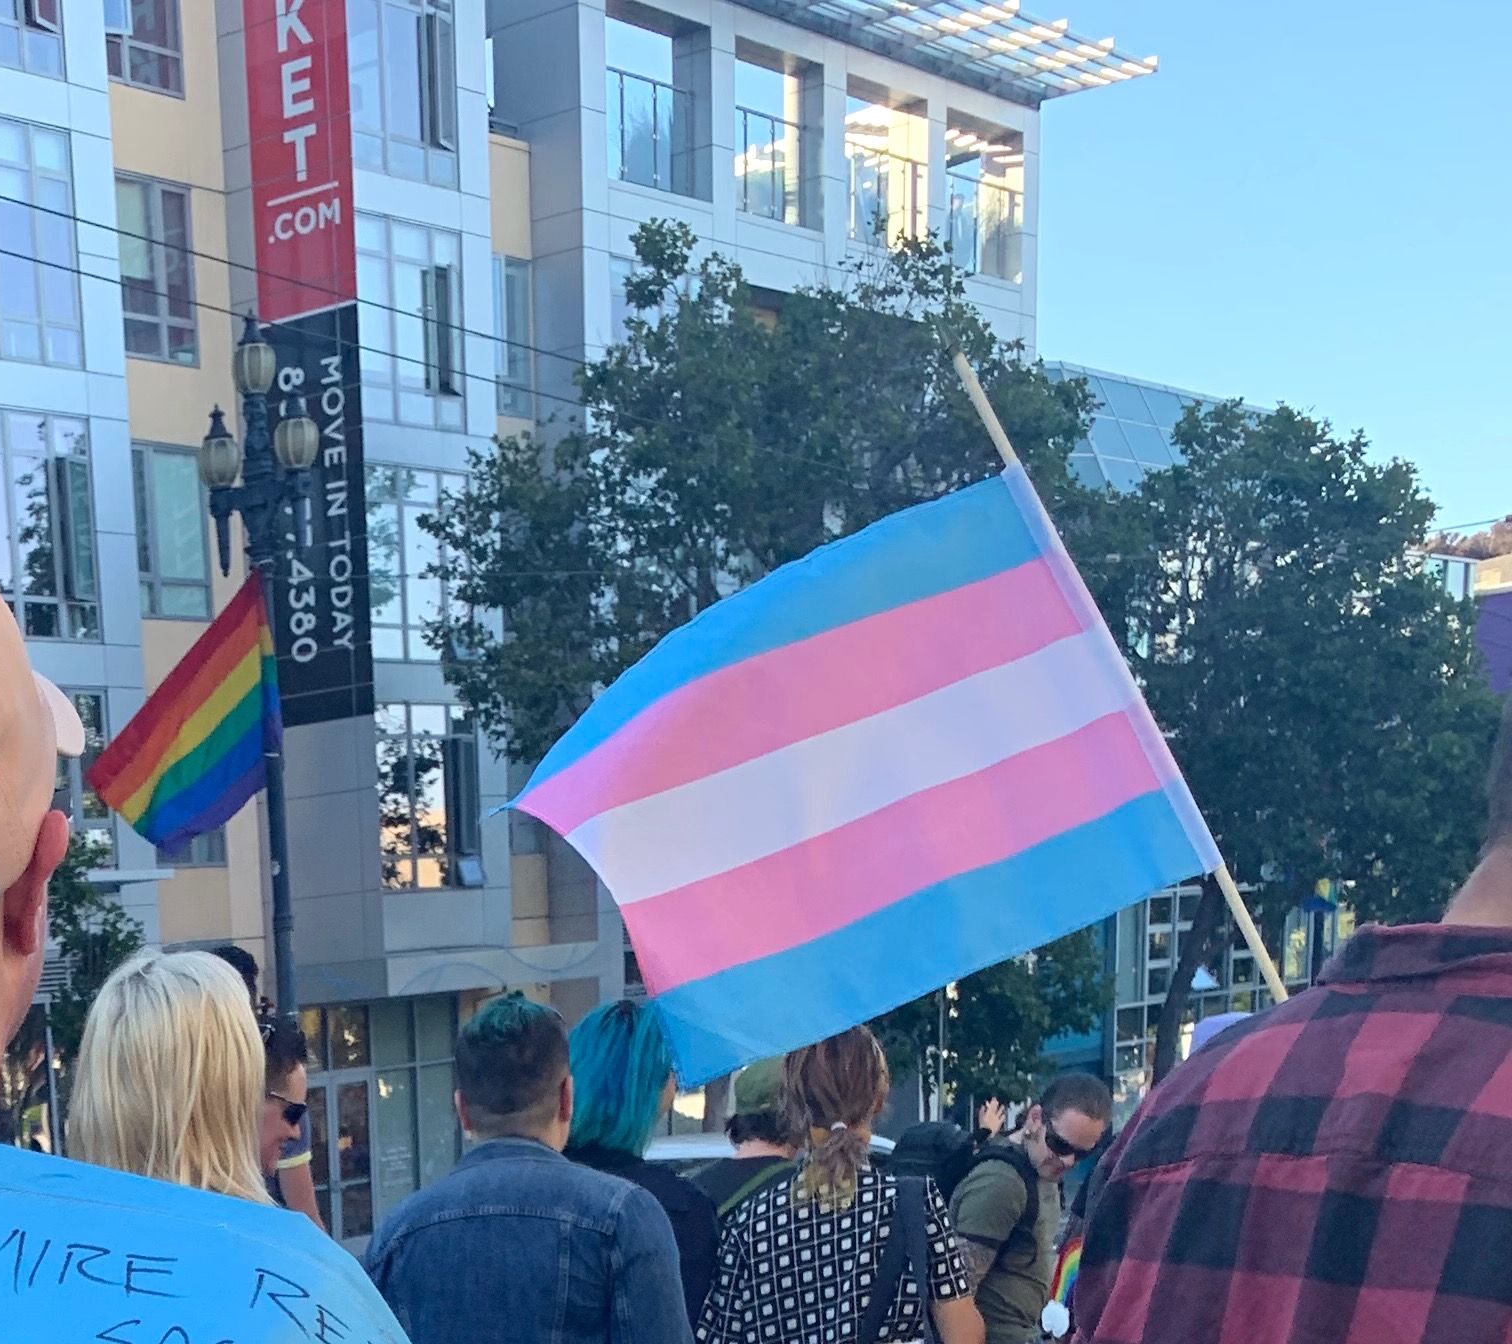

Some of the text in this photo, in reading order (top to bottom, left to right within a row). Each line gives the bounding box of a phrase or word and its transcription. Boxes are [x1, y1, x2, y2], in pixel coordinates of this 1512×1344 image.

[268, 198, 341, 244] .COM
[320, 355, 355, 650] MOVE IN TODAY
